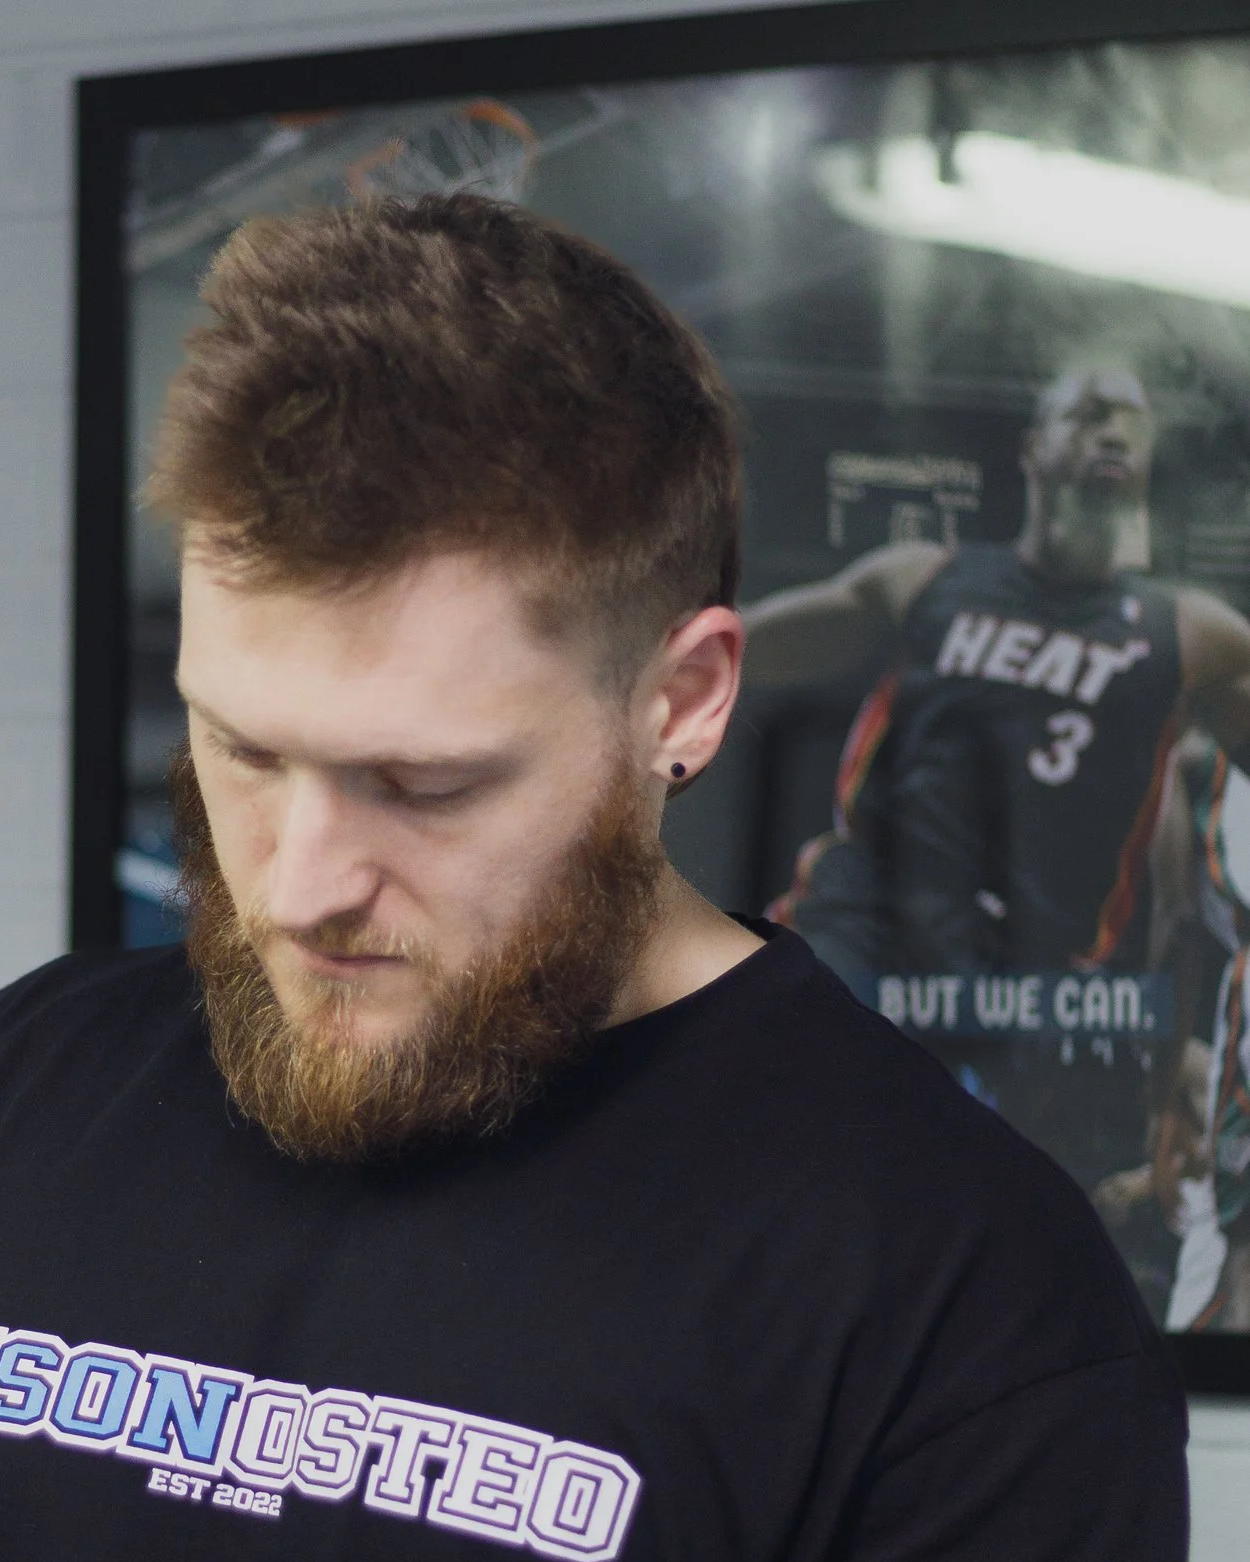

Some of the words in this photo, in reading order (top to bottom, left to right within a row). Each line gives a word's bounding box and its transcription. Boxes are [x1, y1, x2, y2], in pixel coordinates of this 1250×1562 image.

[936, 612, 1149, 704] HEAT
[1029, 711, 1093, 786] 3
[878, 975, 963, 1029] BUT
[973, 975, 1043, 1031] WE
[147, 1467, 211, 1500] EST
[211, 1483, 283, 1517] 2022
